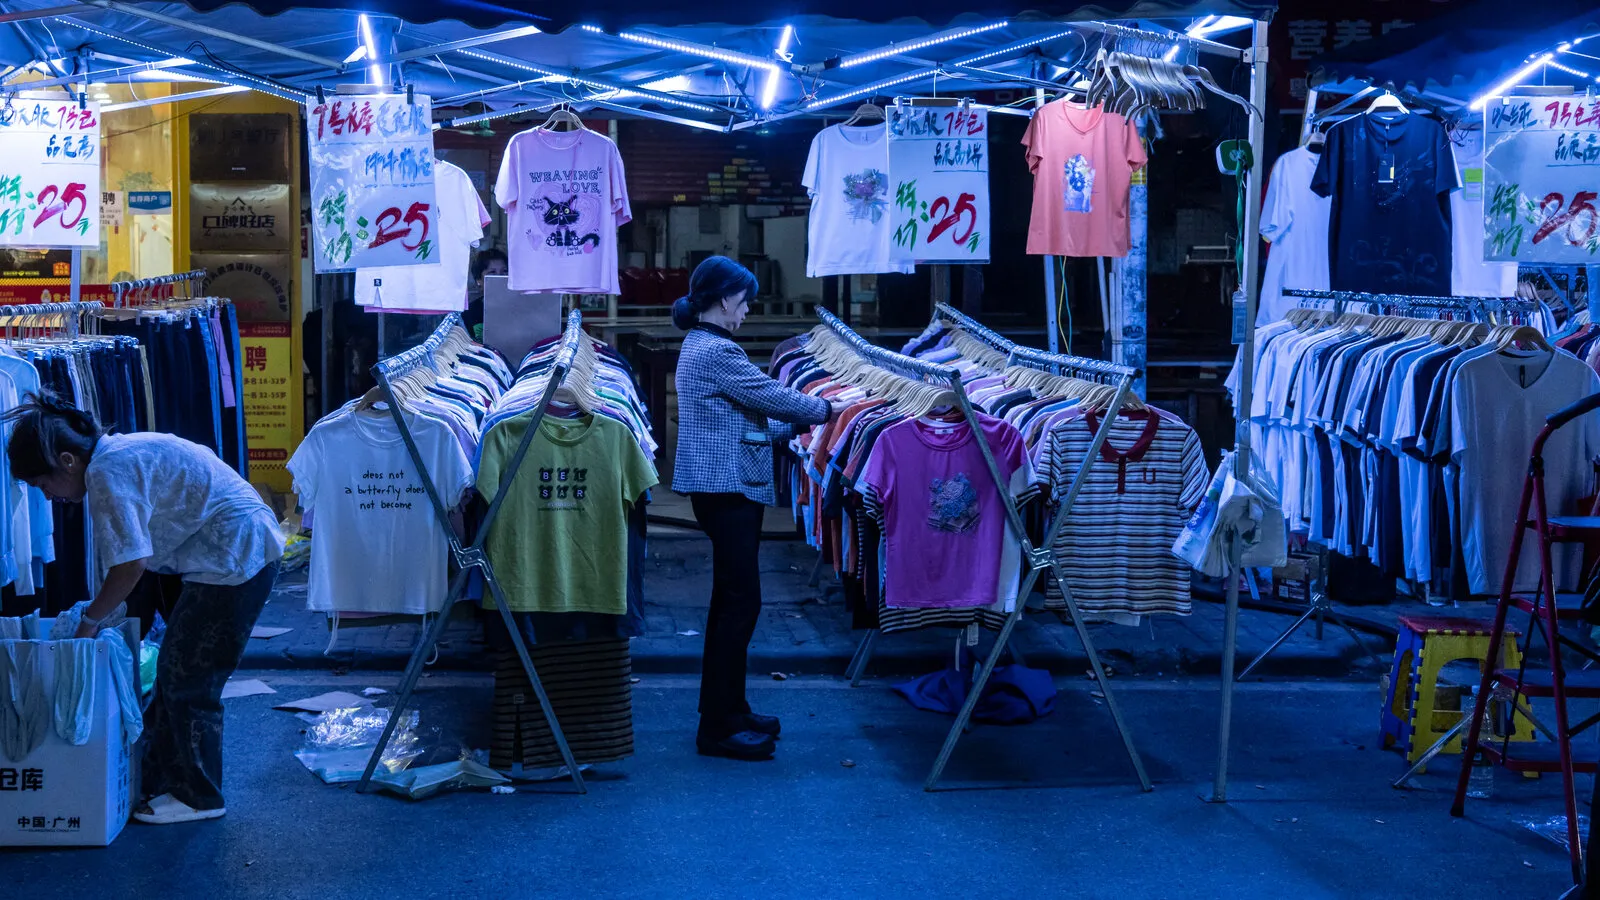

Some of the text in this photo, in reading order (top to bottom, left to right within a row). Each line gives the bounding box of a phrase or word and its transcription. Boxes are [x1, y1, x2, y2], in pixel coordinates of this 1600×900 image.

[529, 169, 599, 183] WEAVING
[561, 182, 599, 193] LOVE
[102, 192, 116, 205] 聘
[202, 214, 275, 229] 口牌好店
[245, 346, 267, 372] 聘
[388, 469, 405, 480] not
[345, 484, 425, 501] a butterfly does
[360, 499, 412, 510] not become
[17, 816, 80, 828] 中国·广州
